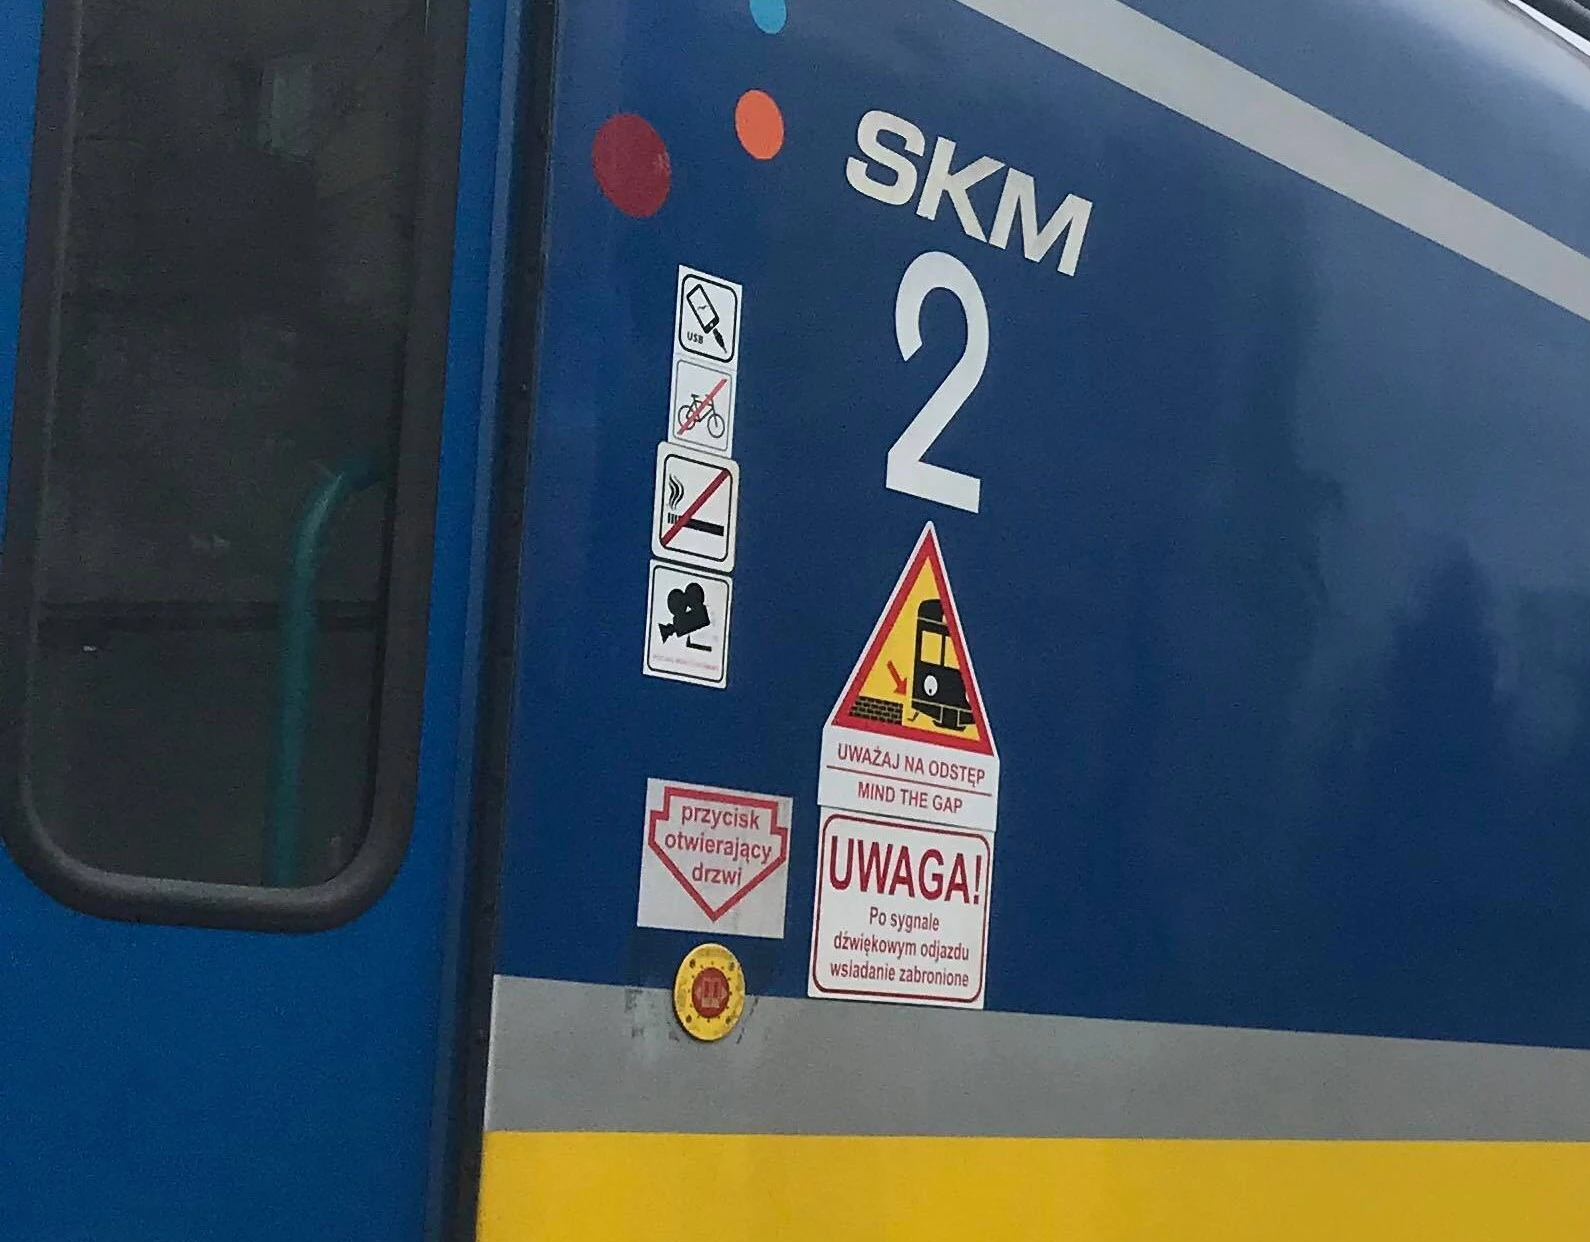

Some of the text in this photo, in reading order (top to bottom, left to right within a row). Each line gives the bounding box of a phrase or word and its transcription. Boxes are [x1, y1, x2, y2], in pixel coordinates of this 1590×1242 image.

[846, 110, 1093, 277] SKM
[687, 331, 704, 345] USB
[886, 251, 989, 514] 2
[838, 743, 985, 788] UWAŻAJ NA ODSTĘP
[858, 782, 963, 813] MIND THE GAP
[681, 805, 760, 830] przycisk
[664, 832, 773, 864] otwierający
[692, 862, 743, 887] drzwi
[829, 835, 982, 905] UWAGA!
[869, 907, 940, 933] Po sygnale
[833, 930, 969, 963] dźwiękowym odjazdu
[830, 960, 969, 987] wsiadanie zabronione
